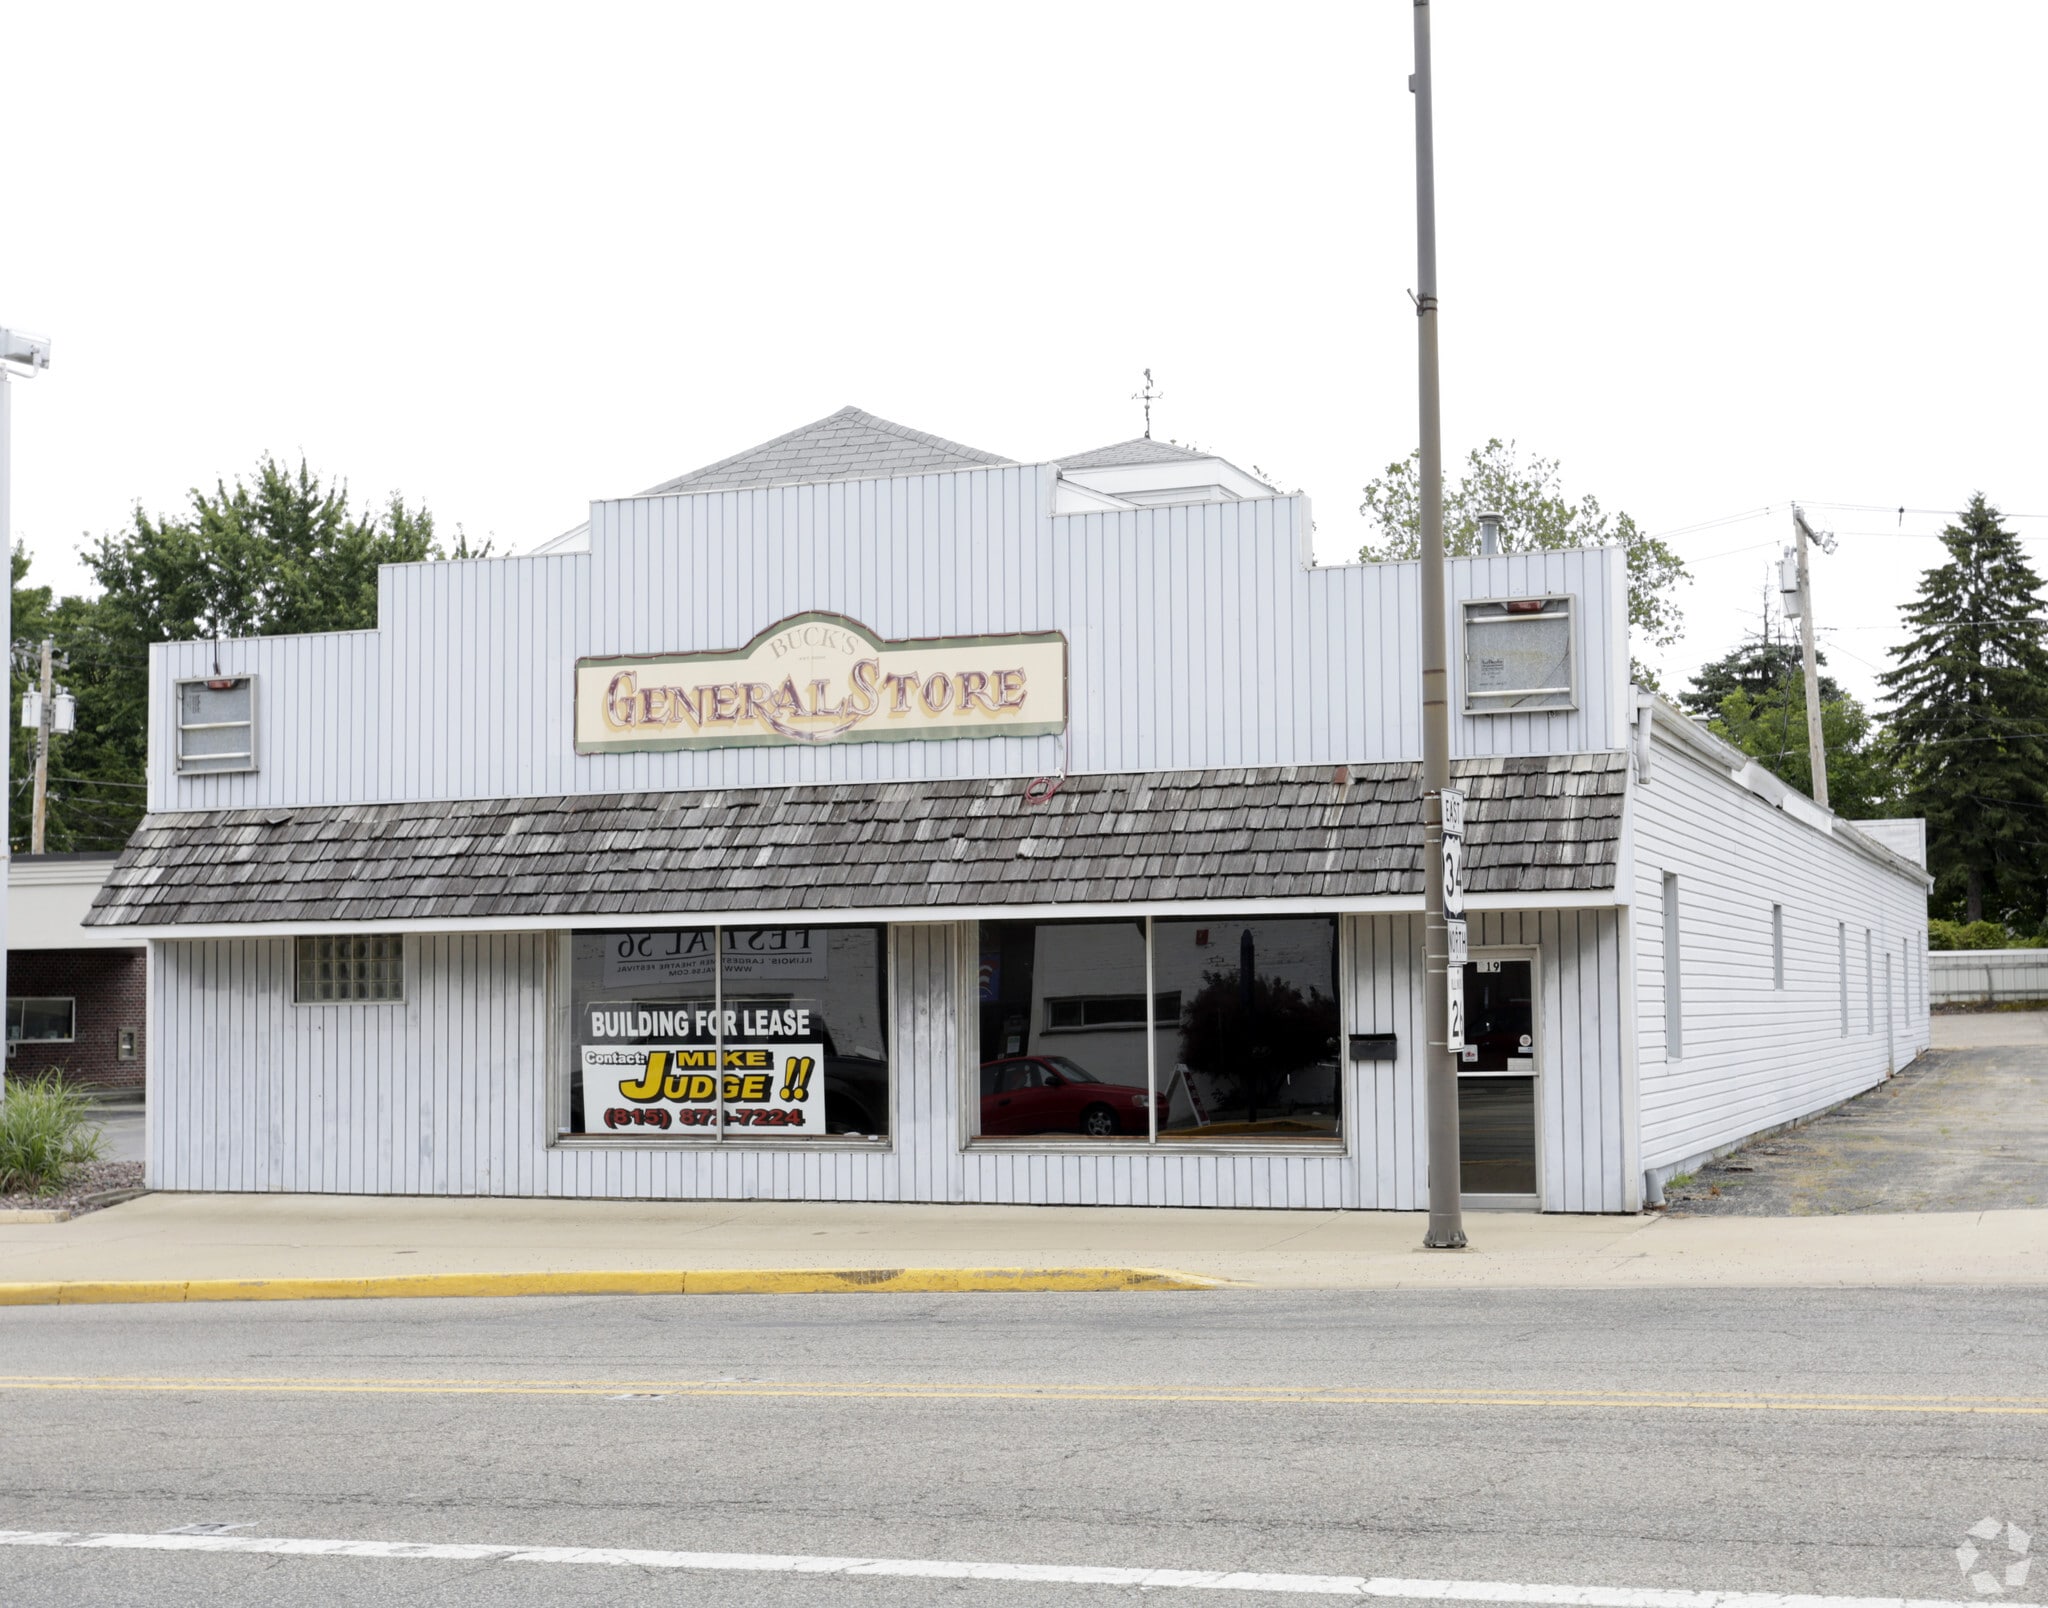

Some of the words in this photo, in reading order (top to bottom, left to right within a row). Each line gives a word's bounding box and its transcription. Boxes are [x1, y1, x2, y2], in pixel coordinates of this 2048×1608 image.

[769, 626, 859, 658] BUCK'S
[606, 670, 847, 733] GENERAL
[848, 658, 1028, 719] STORE
[1445, 799, 1460, 825] EAST
[1445, 852, 1463, 898] 34
[591, 1010, 689, 1037] BUILDING
[695, 1010, 738, 1037] FOR
[743, 1009, 811, 1036] LEASE
[585, 1051, 647, 1065] Contact:
[675, 1050, 774, 1071] MIKE
[603, 1108, 671, 1129] (815)
